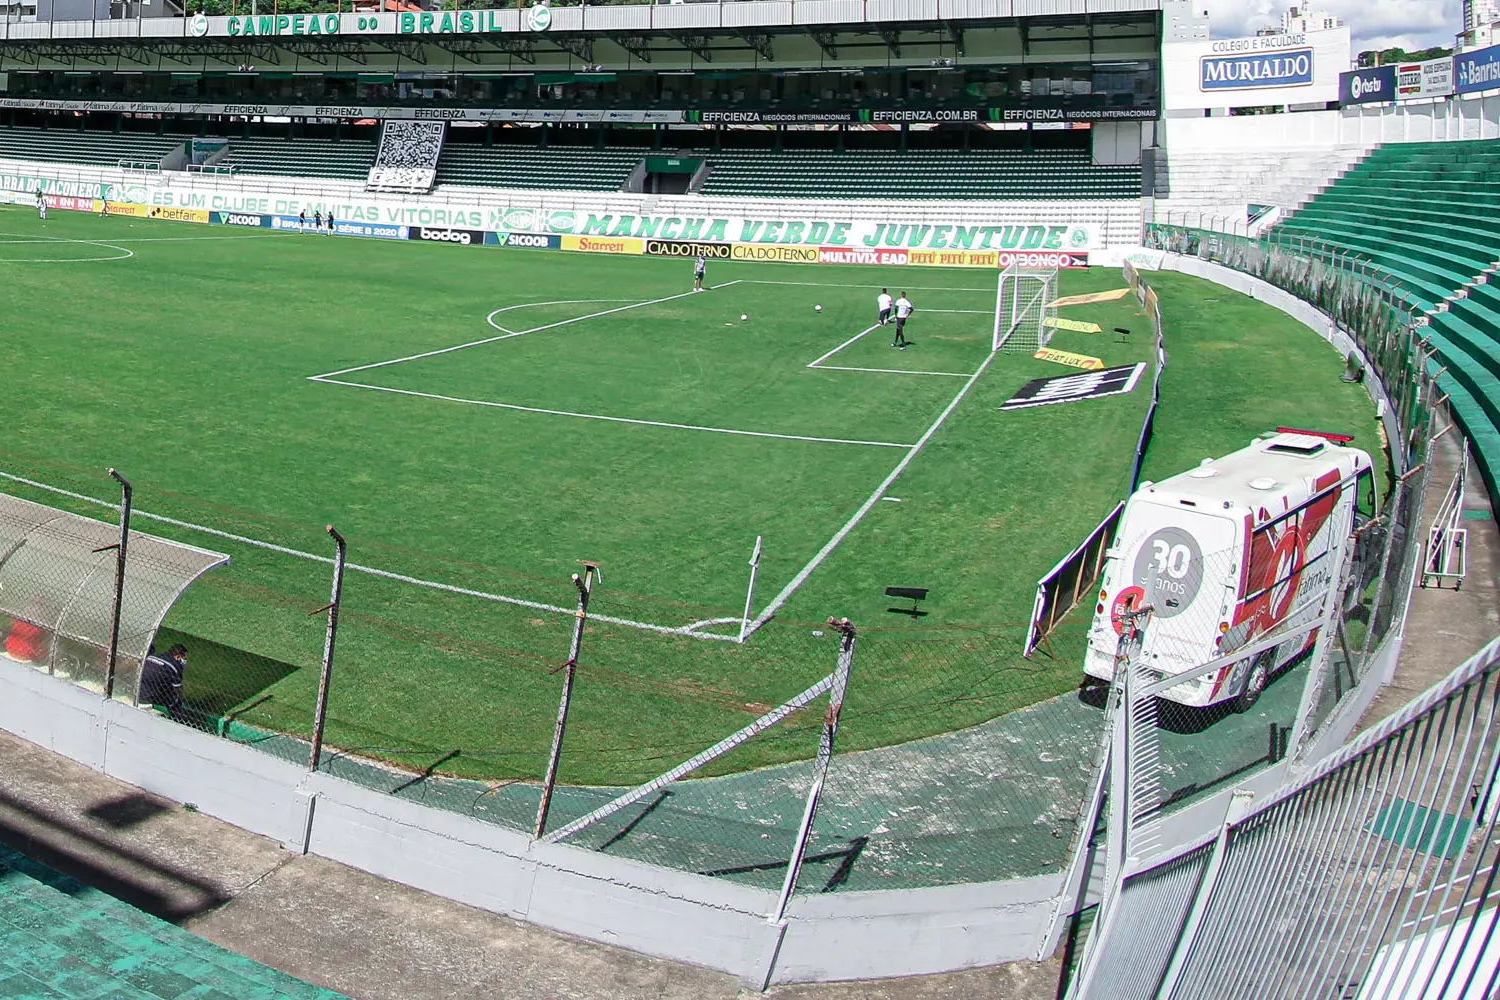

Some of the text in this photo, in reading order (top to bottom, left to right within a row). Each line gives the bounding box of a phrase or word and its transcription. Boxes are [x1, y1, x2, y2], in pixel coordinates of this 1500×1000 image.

[358, 17, 378, 30] DO
[401, 11, 503, 34] BRASIL
[1252, 41, 1258, 49] E
[1260, 34, 1307, 48] FACULDADE
[1204, 54, 1309, 82] MURIALDO
[224, 105, 268, 114] EFFICIENZA
[315, 107, 363, 117] EFFICIENZA
[415, 109, 467, 118] EFFICIENZA
[702, 112, 760, 122] EFFICIENZA
[797, 113, 851, 121] INTERNACIONAIS
[873, 110, 978, 121] EFFICIENZA.COM.BR
[1003, 109, 1157, 120] EFFICIENZA NEGÓCIOS INTERNACIONAIS
[41, 179, 101, 199] JACONERO
[180, 193, 206, 208] UM
[211, 195, 270, 213] CLUBE
[275, 199, 300, 215] DE
[306, 202, 380, 221] MUITAS
[386, 207, 483, 227] VITÓRIAS
[228, 214, 261, 226] SICOOB
[338, 224, 363, 235] SÉRIE
[365, 226, 372, 235] B
[373, 227, 397, 237] 2020
[420, 227, 471, 245] bodog
[581, 213, 1069, 250] MANCHA VERDE JUVENTUDE
[508, 235, 549, 247] SICOOB
[579, 237, 624, 252] Starrett
[819, 250, 908, 265] MULTIVIX EAD
[999, 252, 1070, 267] ONBONGO
[1046, 349, 1082, 366] FIAT LUX
[1148, 538, 1192, 580] 30
[1155, 577, 1187, 596] anos
